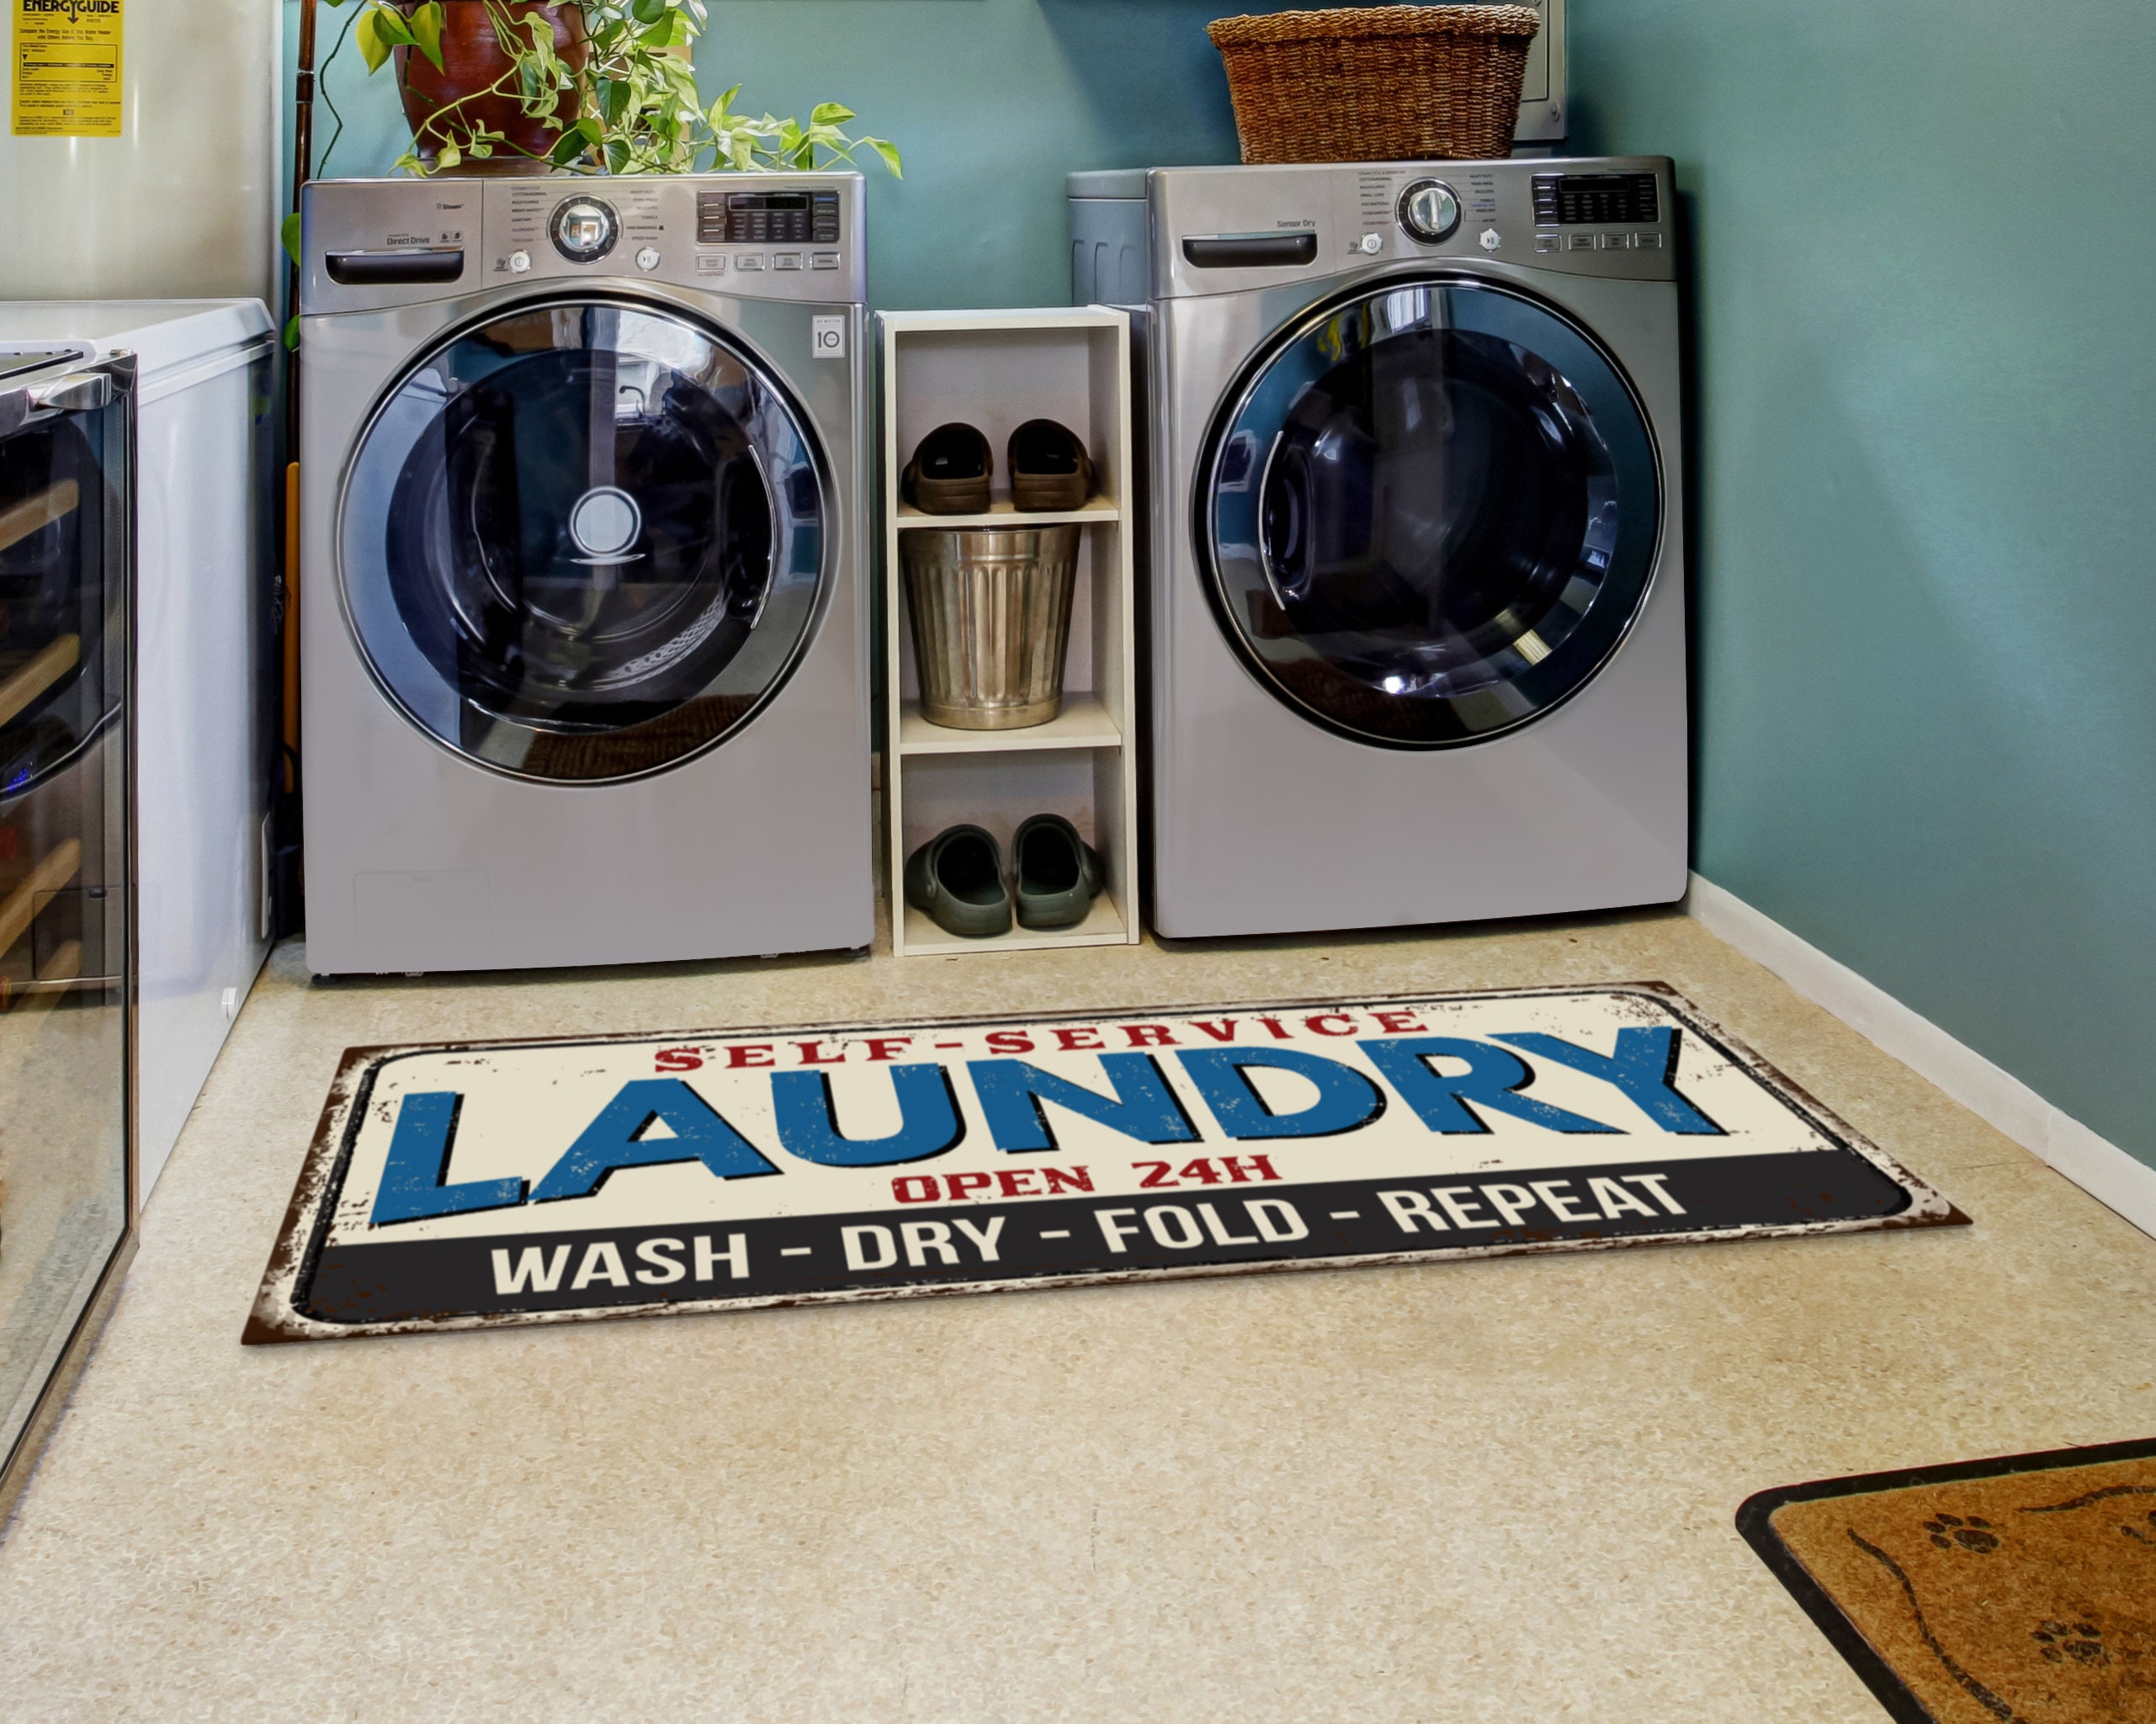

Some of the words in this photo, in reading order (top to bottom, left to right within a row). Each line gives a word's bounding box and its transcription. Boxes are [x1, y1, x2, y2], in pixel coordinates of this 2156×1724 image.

[24, 0, 119, 13] ENERGYGUIDE
[817, 331, 840, 348] 10
[656, 1012, 1428, 1072] SELF-SERVICE
[370, 1027, 1730, 1227] LAUNDRY
[892, 1167, 1095, 1204] OPEN
[1133, 1156, 1281, 1188] 24H
[491, 1233, 750, 1295] WASH
[841, 1216, 1006, 1271] DRY
[1094, 1199, 1309, 1253] FOLD
[1376, 1173, 1686, 1233] REPEAT
